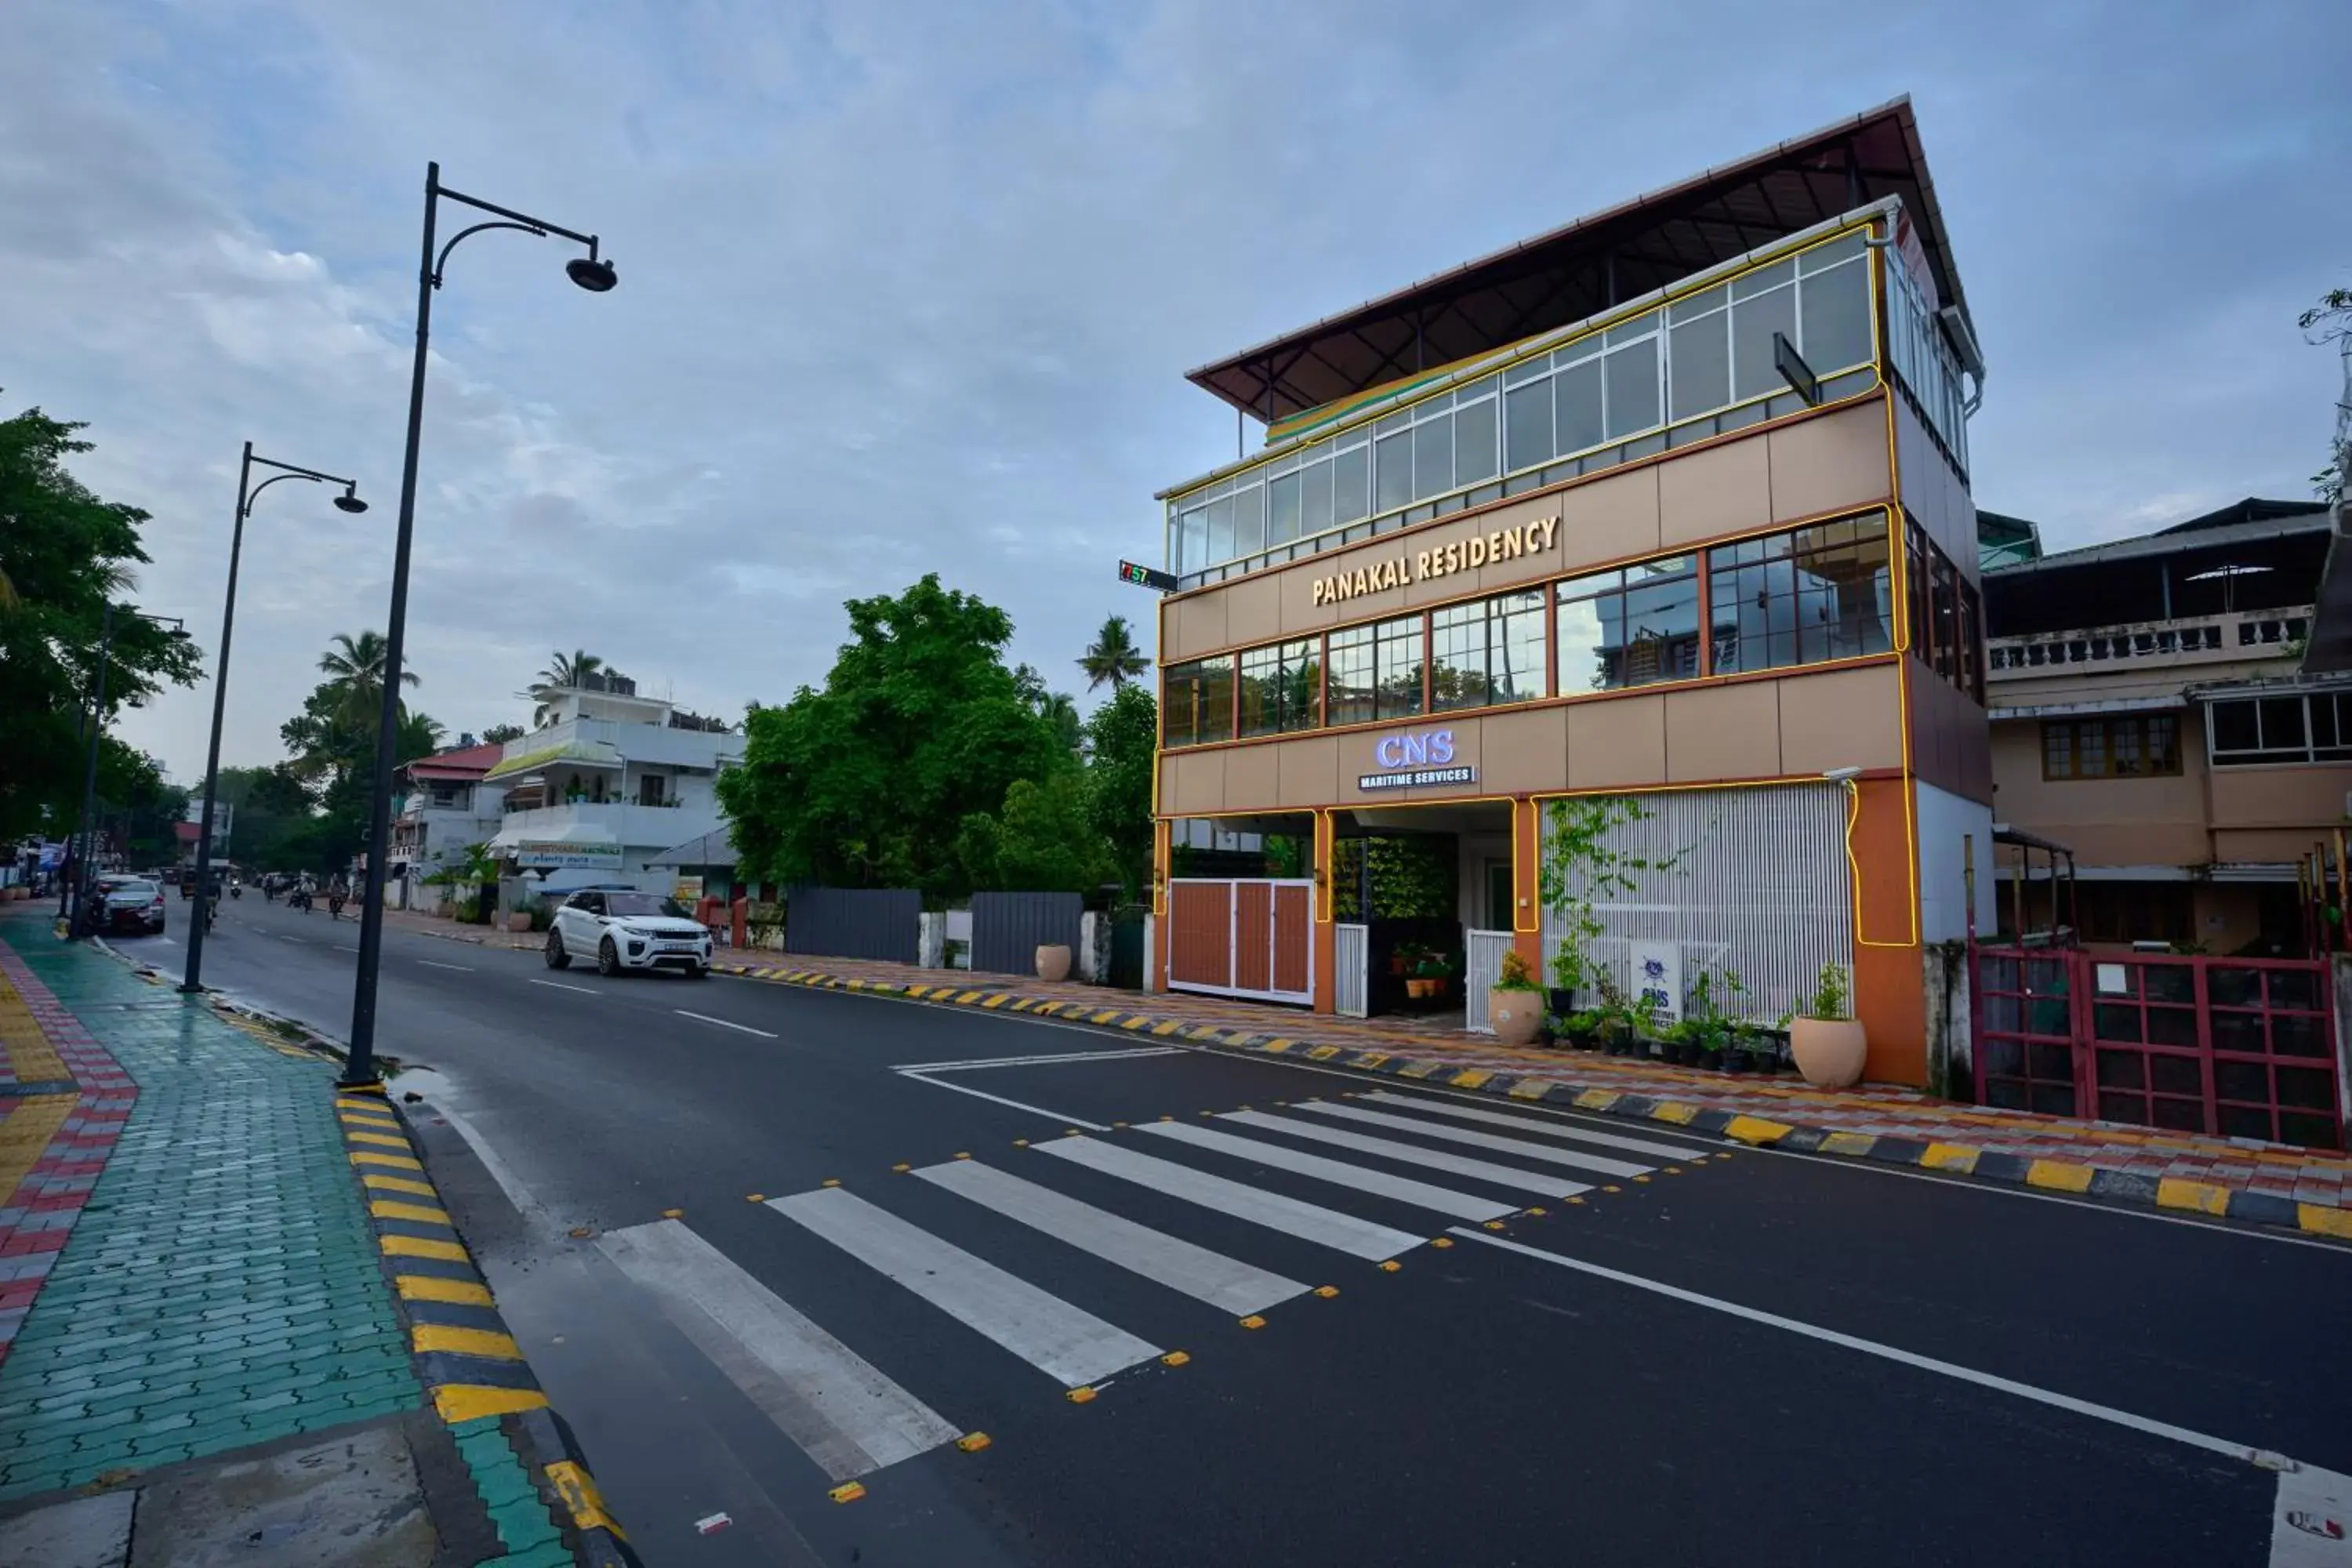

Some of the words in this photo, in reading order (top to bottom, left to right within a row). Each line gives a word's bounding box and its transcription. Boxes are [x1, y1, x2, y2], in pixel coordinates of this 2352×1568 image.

[1312, 556, 1411, 606] PANAKAL
[1417, 515, 1559, 580] RESIDENCY
[1377, 730, 1454, 768] CNS
[1360, 773, 1413, 788] MARITIME
[1415, 768, 1468, 784] SERVICES
